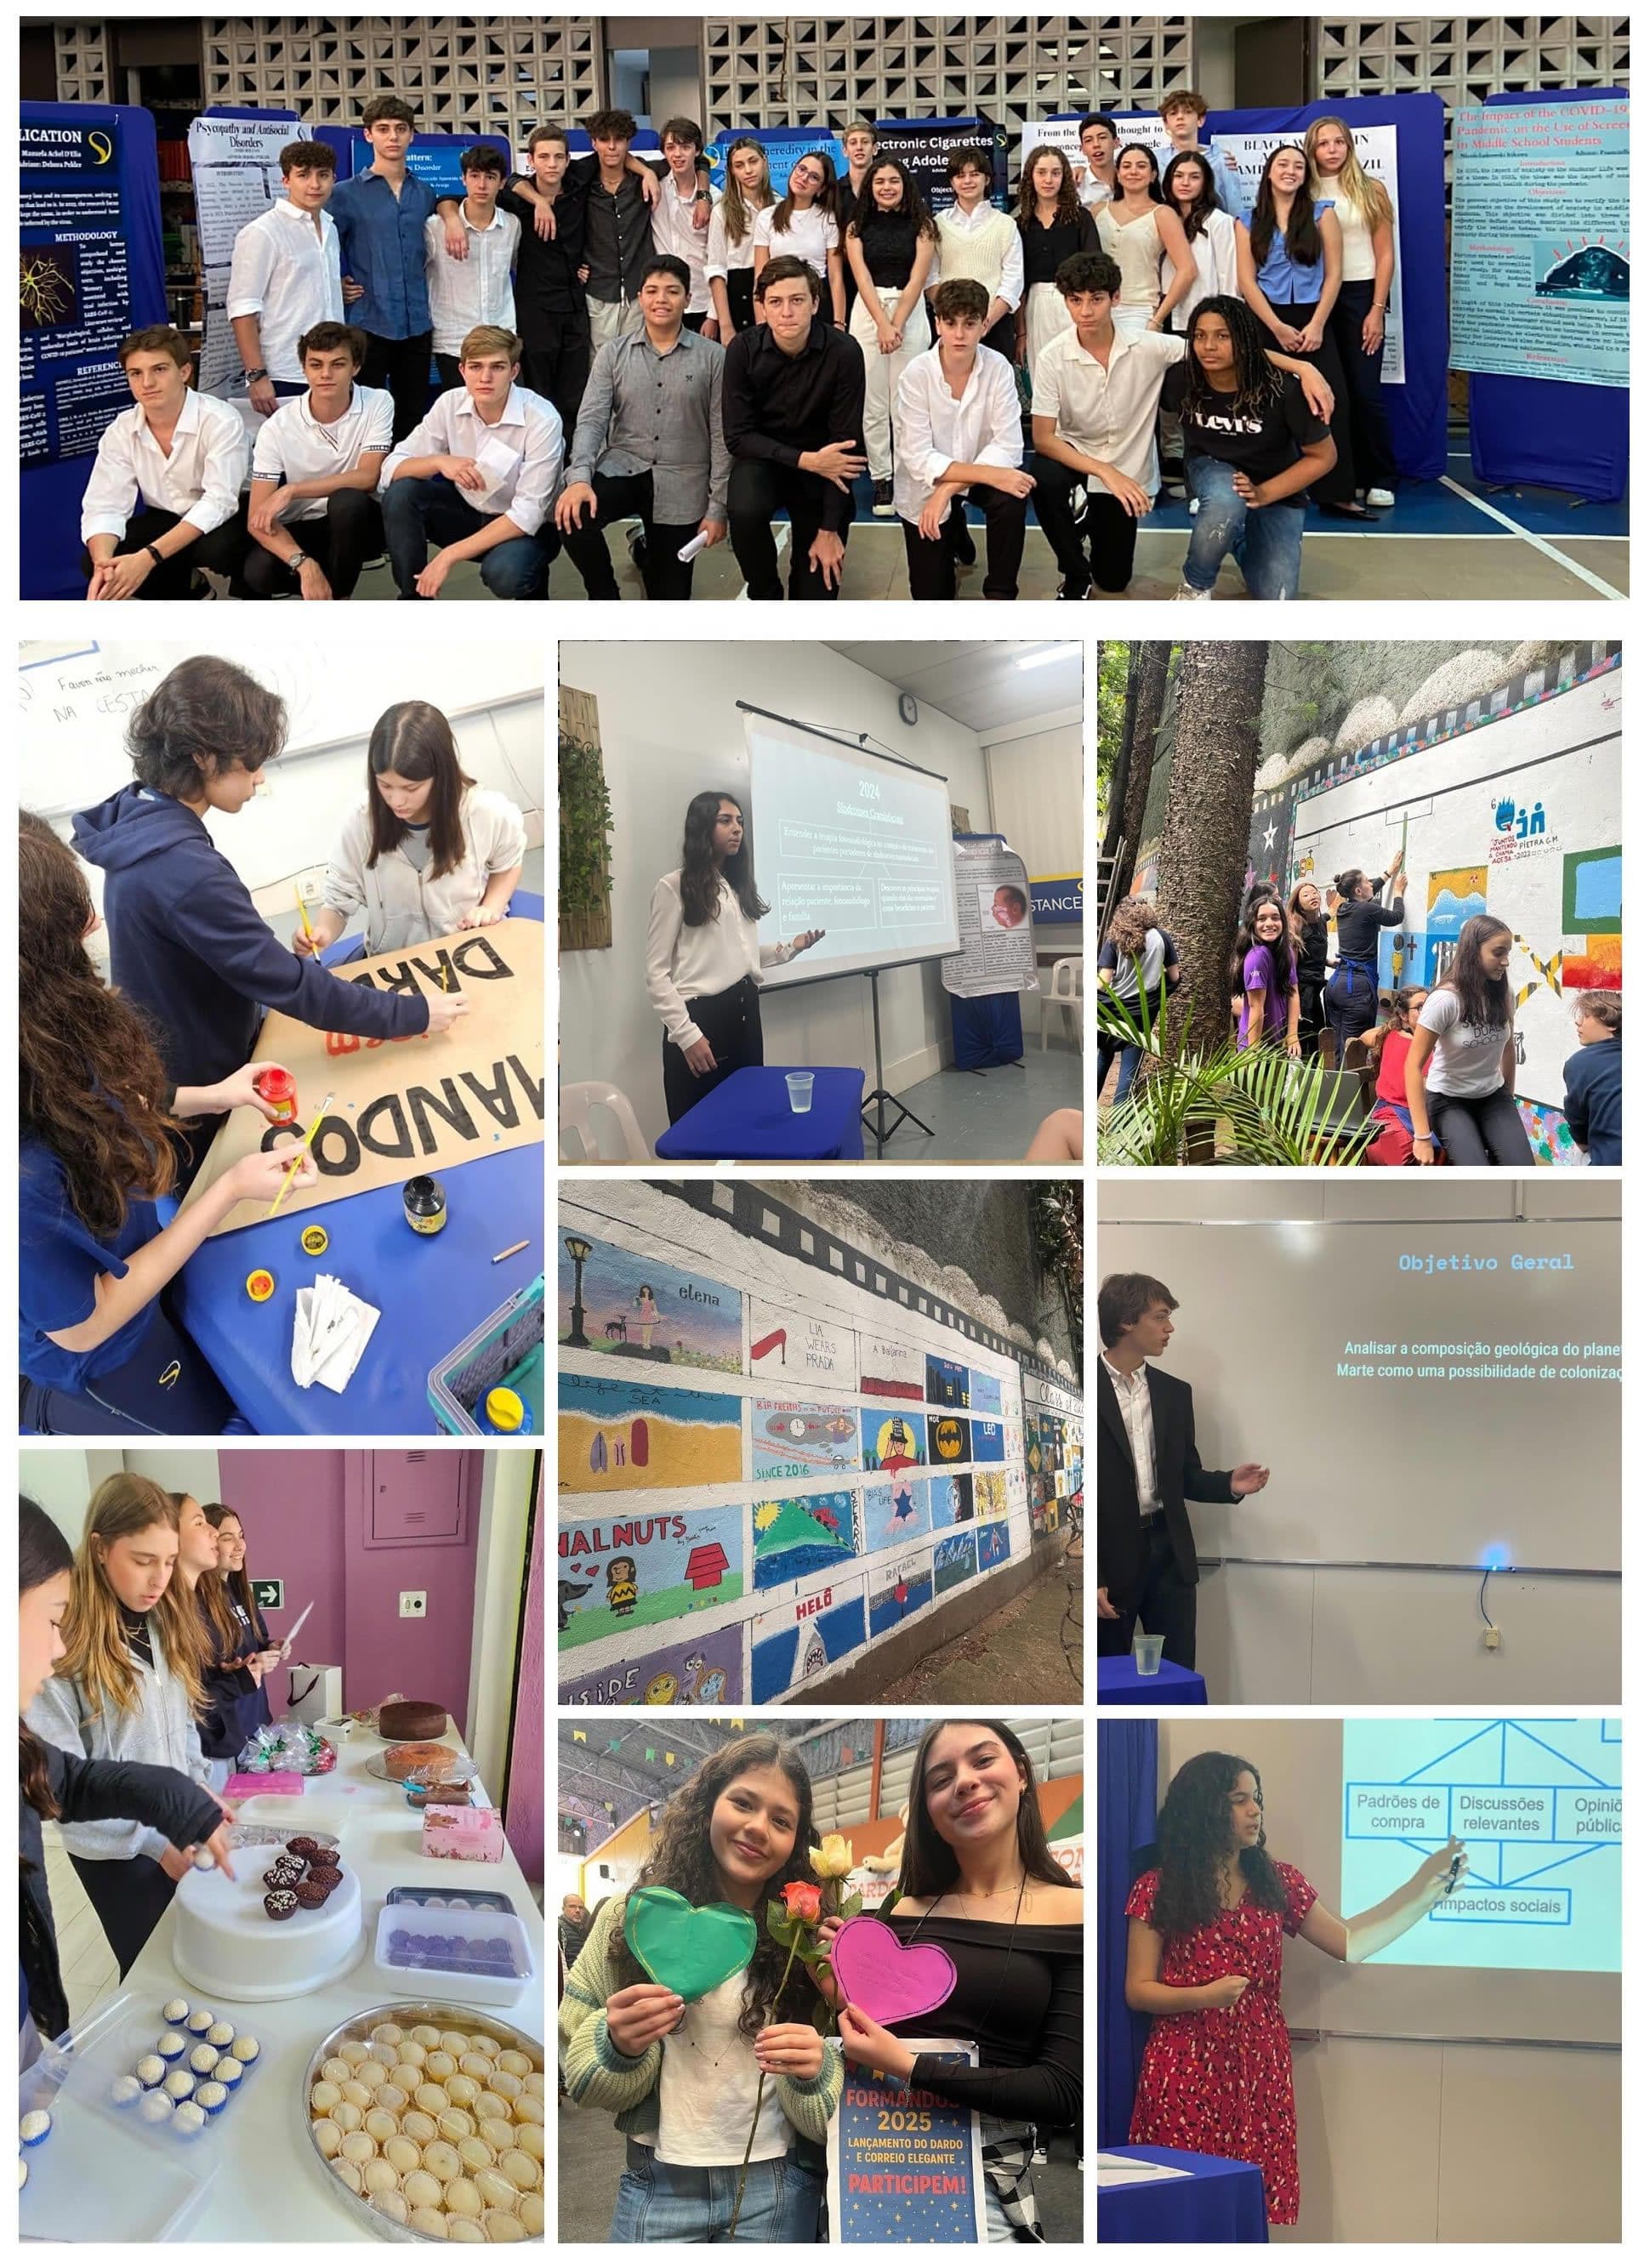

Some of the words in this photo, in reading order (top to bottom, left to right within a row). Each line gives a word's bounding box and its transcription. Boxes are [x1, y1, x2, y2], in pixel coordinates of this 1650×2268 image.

[1459, 111, 1478, 122] The
[1482, 109, 1519, 122] Impact
[1524, 111, 1534, 119] of
[1539, 109, 1556, 118] the
[1560, 104, 1628, 117] COVID-19
[196, 122, 239, 136] Psycopathy
[242, 123, 255, 134] and
[258, 124, 289, 135] Antisocial
[1038, 128, 1061, 137] From
[1063, 128, 1076, 136] the
[1118, 126, 1151, 135] thought
[1457, 124, 1508, 135] Pandemic
[1533, 123, 1550, 133] the
[1555, 122, 1573, 131] Use
[1578, 121, 1589, 130] of
[230, 135, 264, 149] Disorders
[765, 145, 804, 156] heredity
[821, 143, 835, 153] the
[929, 135, 993, 150] Cigarettes
[1244, 140, 1285, 151] BLACK
[1355, 134, 1368, 144] IN
[1472, 138, 1506, 149] Middle
[1511, 136, 1550, 147] School
[1553, 134, 1602, 147] Students
[912, 155, 949, 167] Adole
[54, 230, 117, 242] METHODOLOGY
[53, 705, 77, 724] NA
[858, 780, 880, 799] 2024
[1031, 896, 1081, 912] STANCE
[1399, 1253, 1498, 1274] Objetivo
[1511, 1253, 1574, 1270] Geral
[679, 1284, 720, 1307] elena
[809, 1322, 823, 1338] LIA
[805, 1338, 836, 1354] WEARS
[1345, 1341, 1397, 1355] Analisar
[1400, 1345, 1408, 1355] a
[1411, 1341, 1491, 1359] composição
[1494, 1341, 1559, 1359] geológica
[1562, 1342, 1579, 1356] do
[806, 1353, 834, 1371] PRADA
[1337, 1362, 1374, 1377] Marte
[1377, 1367, 1414, 1378] como
[1417, 1367, 1445, 1378] uma
[1448, 1363, 1535, 1380] possibilidade
[1539, 1364, 1556, 1378] de
[629, 1395, 661, 1405] SEA
[983, 1423, 996, 1435] LEO
[785, 1464, 810, 1478] 2016
[795, 1585, 834, 1621] HELÔ
[1357, 1793, 1417, 1810] Padrões
[1422, 1795, 1440, 1810] de
[1459, 1795, 1545, 1810] Discussões
[1371, 1816, 1425, 1832] compra
[1463, 1816, 1540, 1831] relevantes
[1510, 1896, 1561, 1913] sociais
[878, 2111, 932, 2132] 2025
[848, 2136, 912, 2151] LANÇAMENTO
[914, 2139, 927, 2149] DO
[930, 2139, 964, 2150] DARDO
[856, 2152, 862, 2163] E
[865, 2152, 905, 2163] CORREIO
[908, 2153, 955, 2164] ELEGANTE
[848, 2174, 967, 2195] PARTICIPEM!
